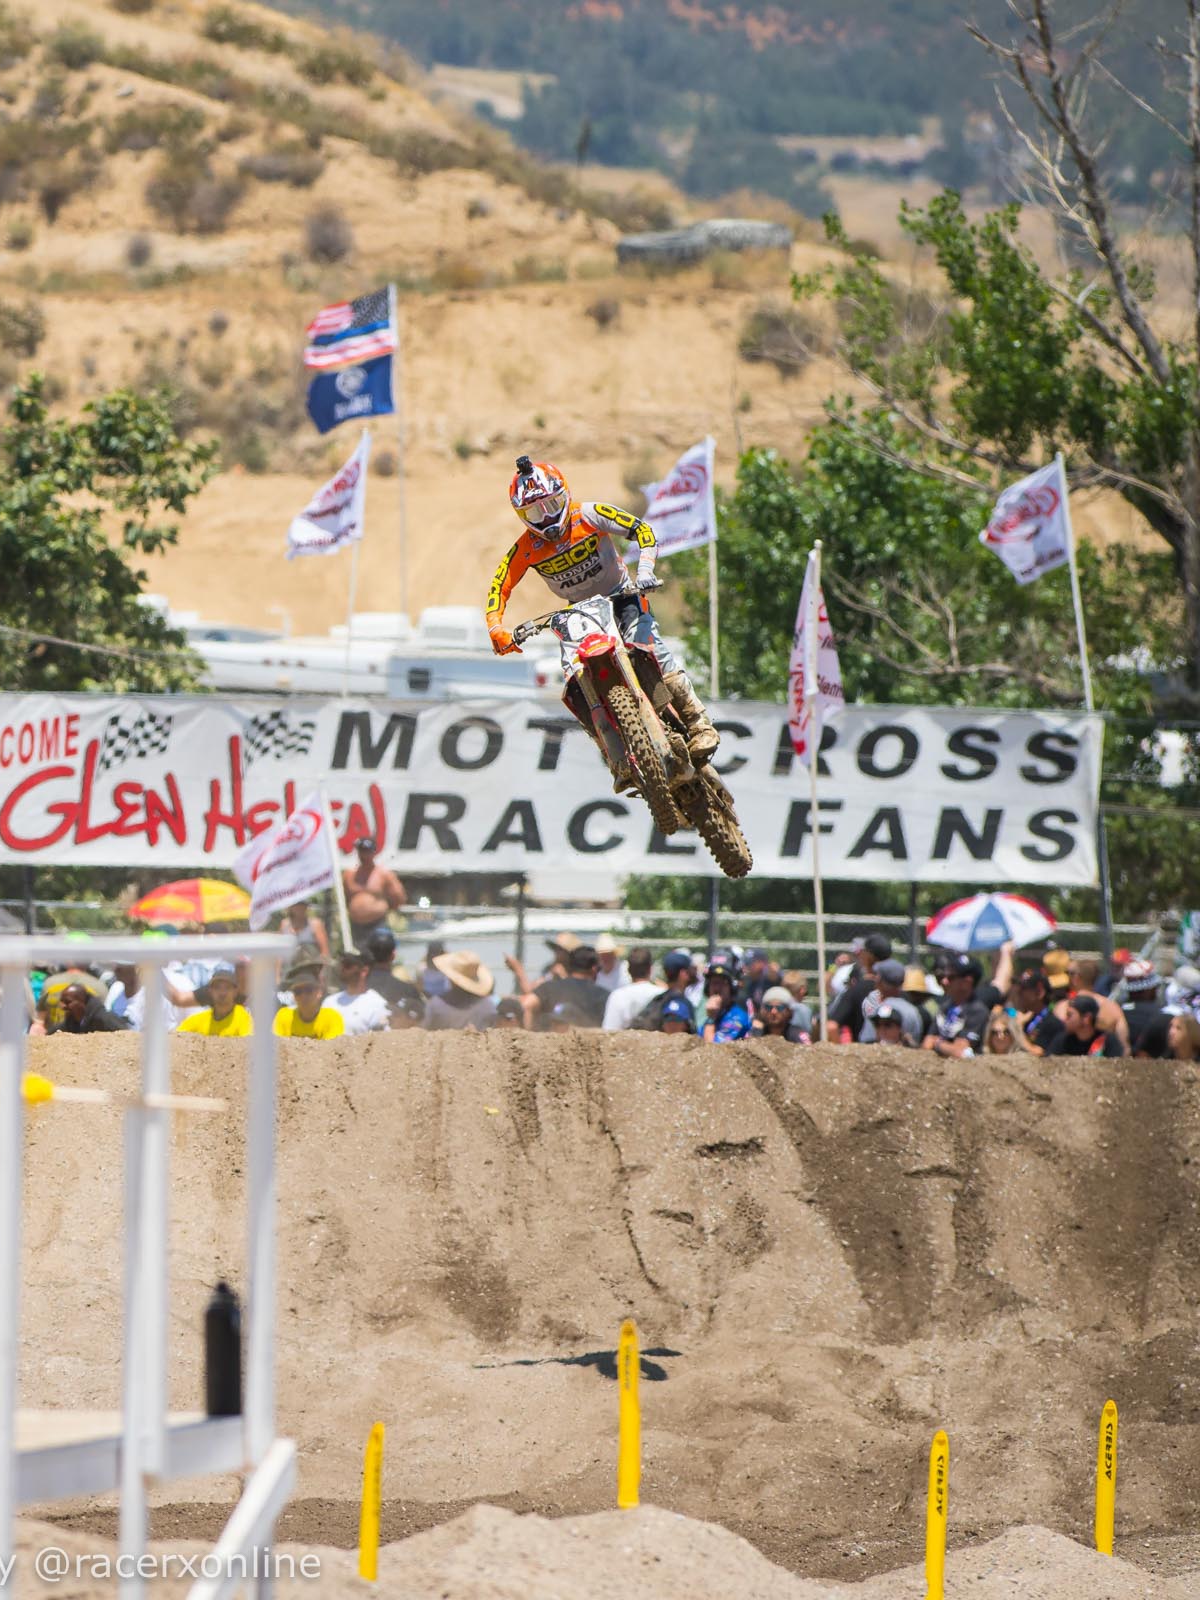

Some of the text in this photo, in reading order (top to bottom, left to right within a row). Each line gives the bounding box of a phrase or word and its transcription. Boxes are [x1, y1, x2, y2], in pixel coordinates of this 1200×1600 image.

[538, 535, 599, 575] GEICO
[552, 556, 599, 581] HONDA
[331, 710, 1081, 785] MOTCROSS
[779, 799, 1080, 863] FANS
[1105, 1422, 1113, 1481] ACERBIS
[936, 1455, 944, 1516] ACERBIS
